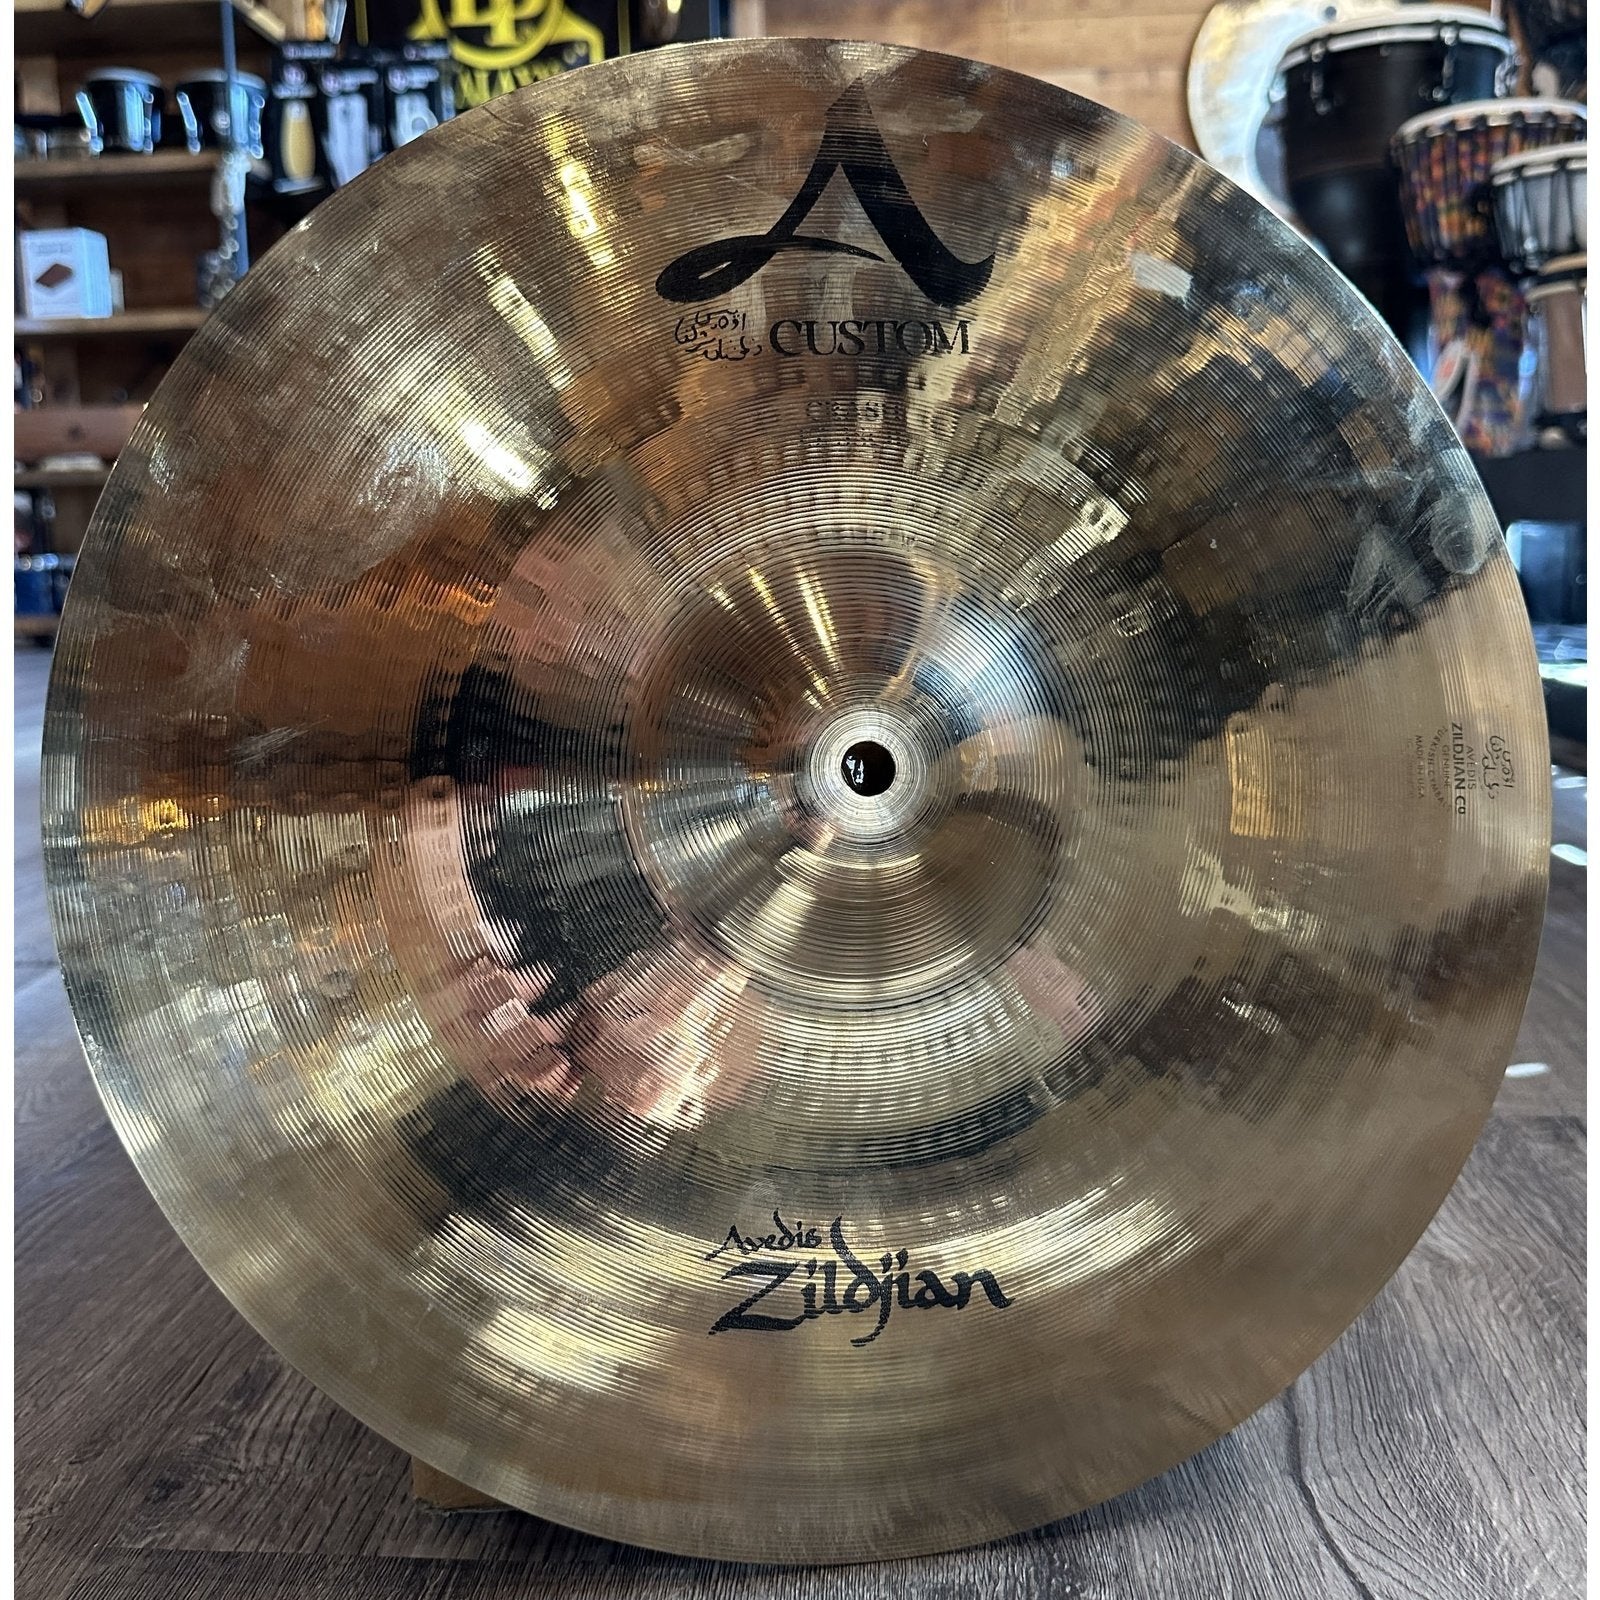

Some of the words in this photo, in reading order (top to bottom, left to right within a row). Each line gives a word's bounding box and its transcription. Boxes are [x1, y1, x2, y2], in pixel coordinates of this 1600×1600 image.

[655, 77, 995, 309] A
[769, 319, 971, 357] CUSTOM
[1451, 722, 1466, 790] ZILDJIAN
[1466, 745, 1477, 791] AVEDIS
[703, 1207, 823, 1261] Avedis
[707, 1214, 1017, 1348] Zildjian
